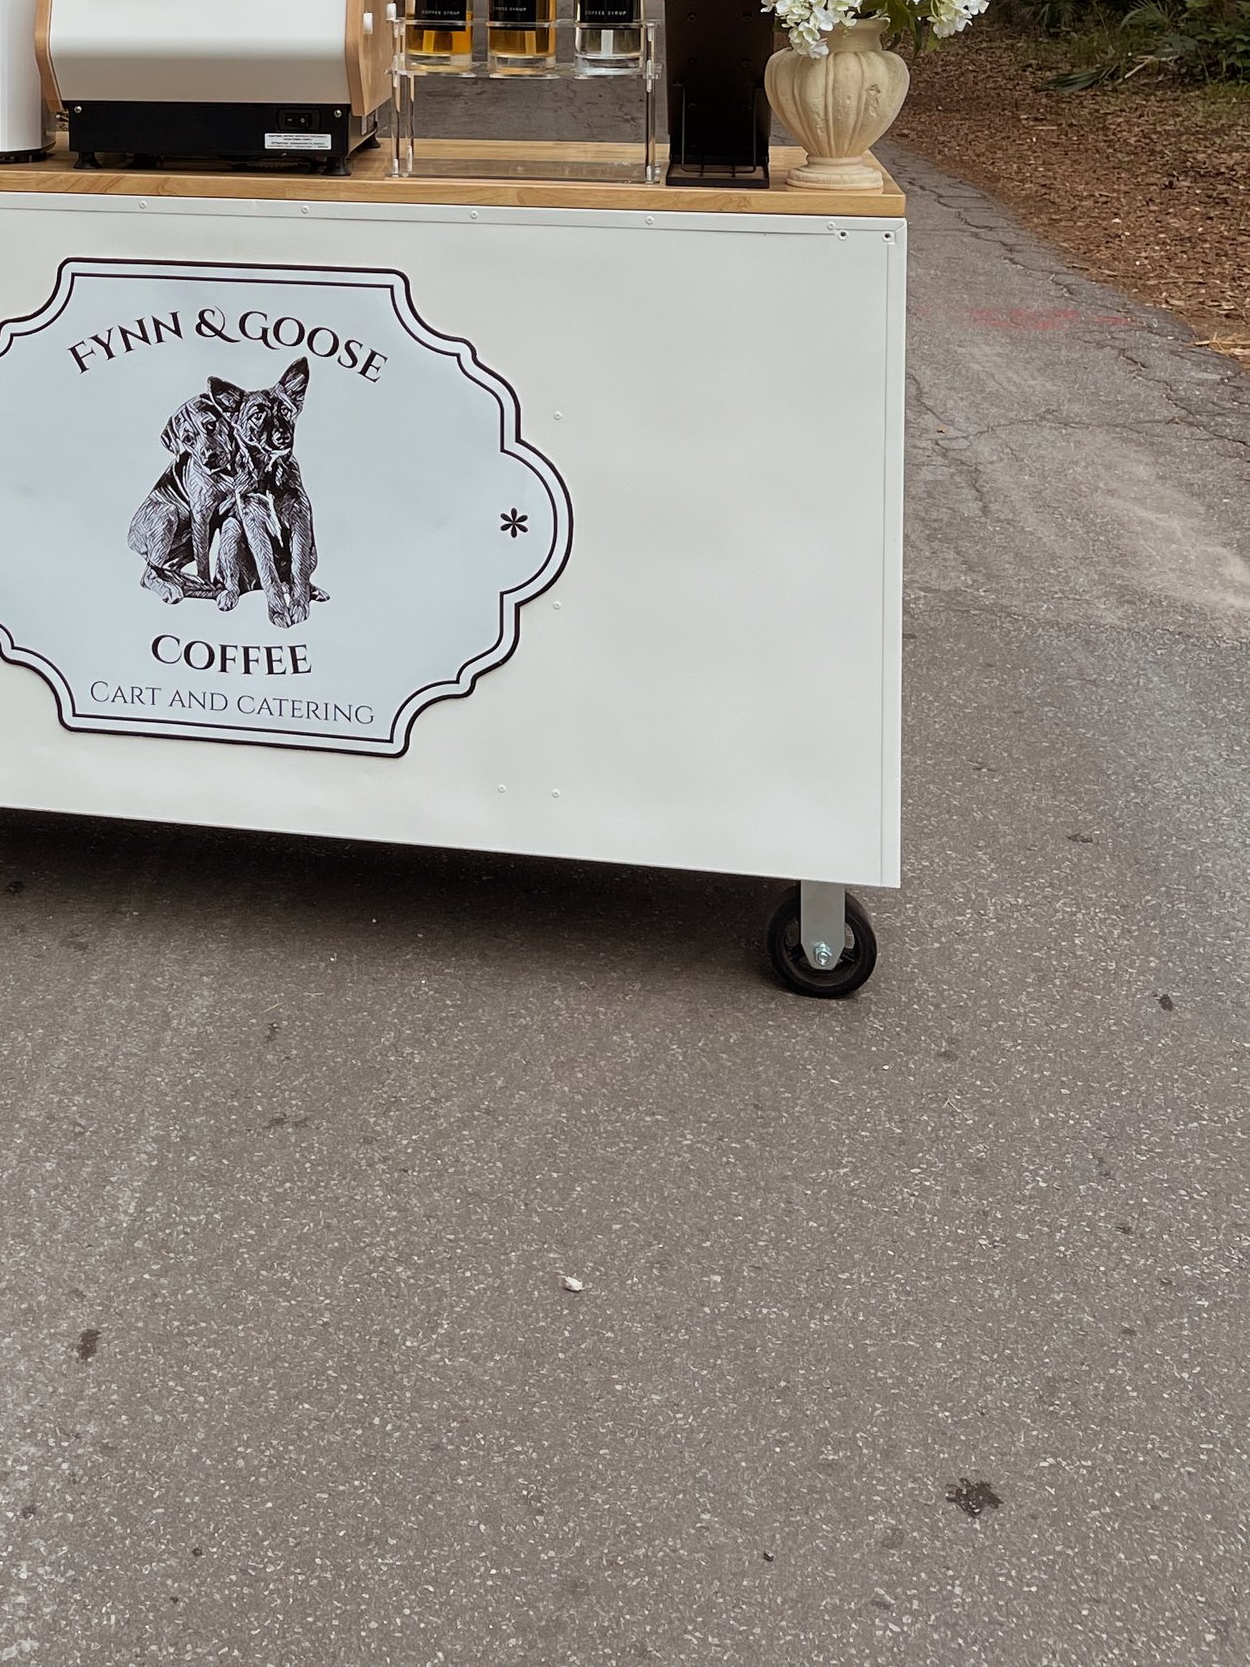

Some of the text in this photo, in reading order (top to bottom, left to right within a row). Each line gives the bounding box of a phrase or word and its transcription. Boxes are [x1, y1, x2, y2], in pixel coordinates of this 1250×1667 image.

[67, 305, 389, 384] FYNN & GOOSE
[151, 634, 312, 676] COFFEE
[90, 680, 375, 725] CART AND CATERING
